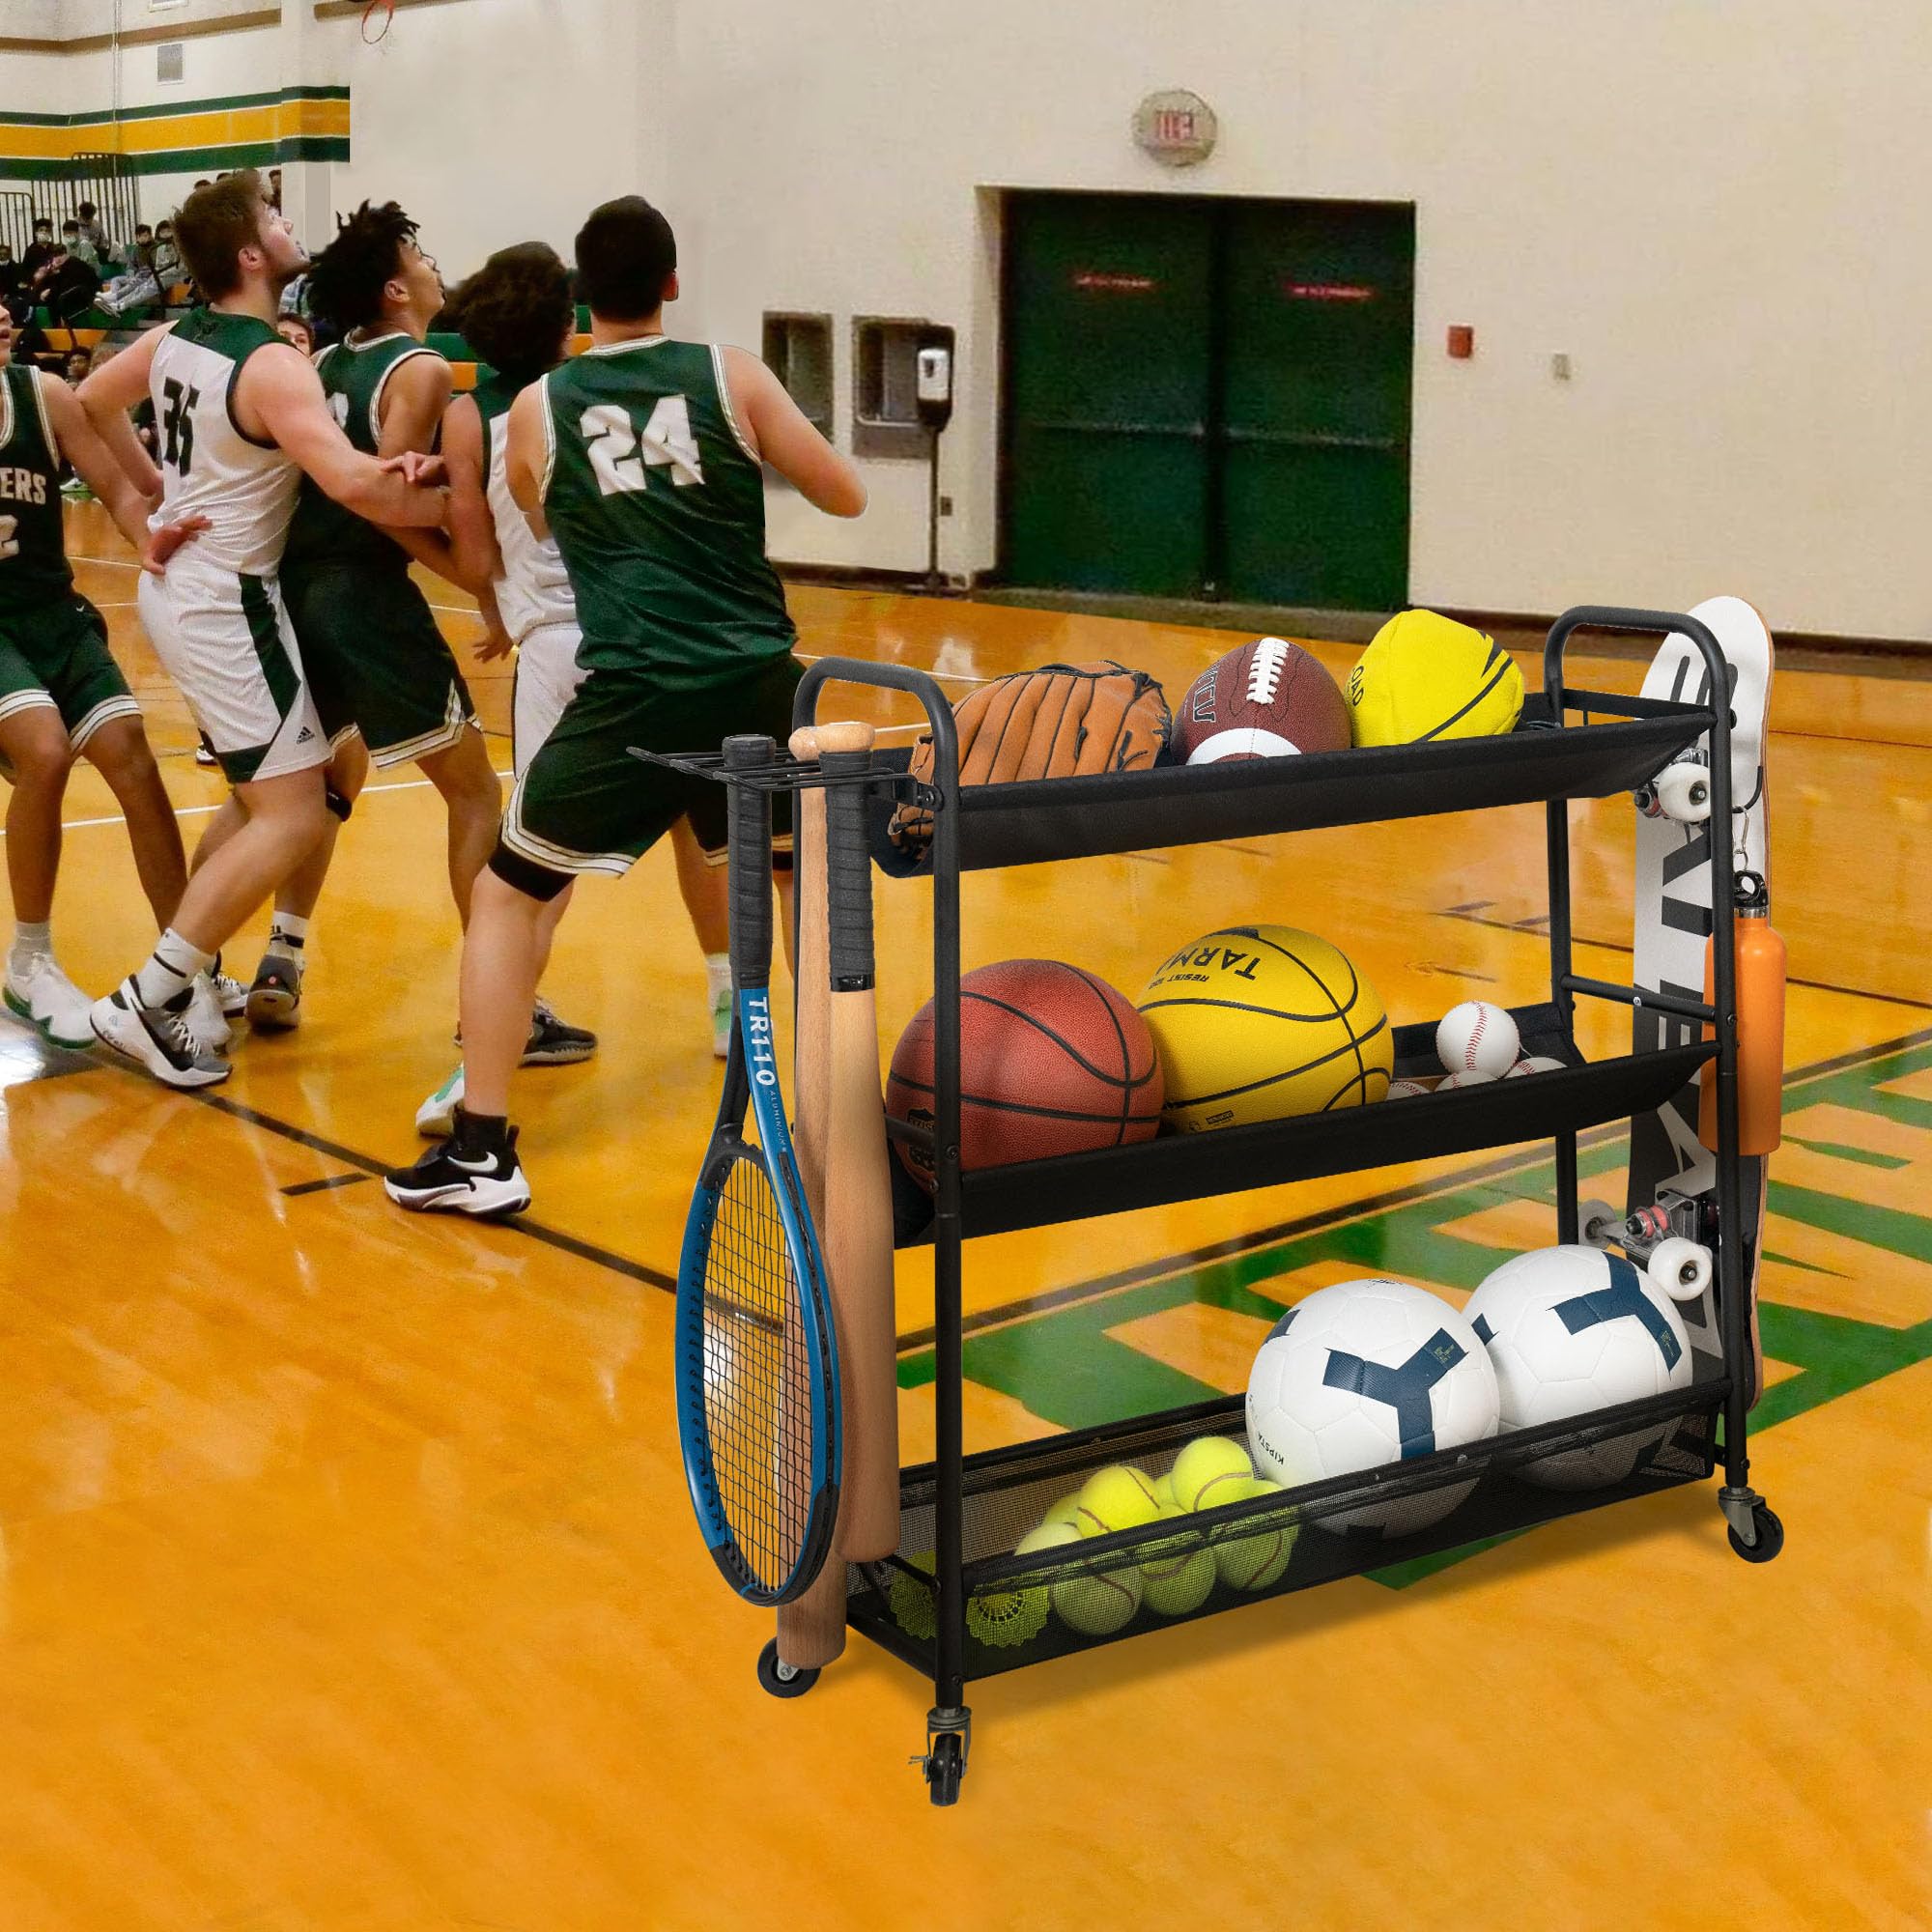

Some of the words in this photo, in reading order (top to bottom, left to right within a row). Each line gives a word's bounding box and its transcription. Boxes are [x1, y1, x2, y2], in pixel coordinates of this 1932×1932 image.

[580, 393, 706, 496] 24
[1167, 973, 1209, 982] RESIST
[749, 996, 776, 1086] TR110
[1258, 1433, 1285, 1465] KIPSTA
